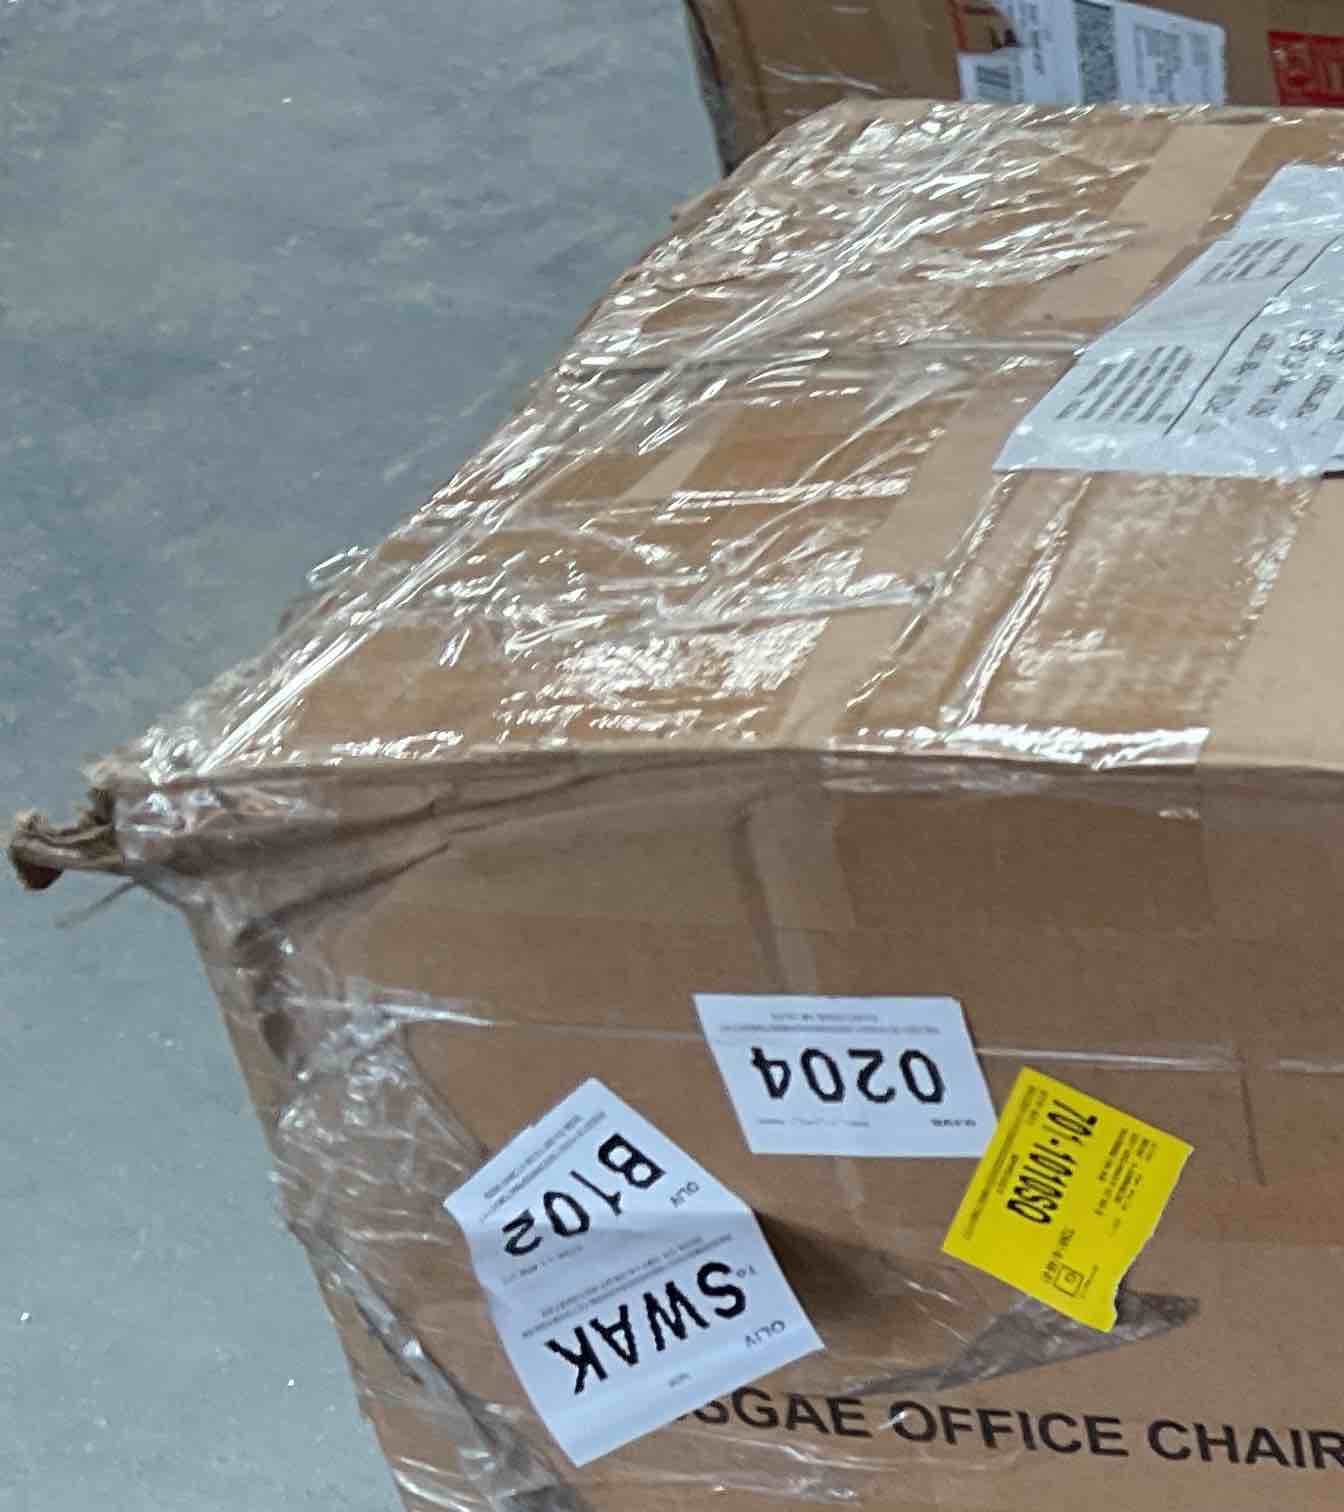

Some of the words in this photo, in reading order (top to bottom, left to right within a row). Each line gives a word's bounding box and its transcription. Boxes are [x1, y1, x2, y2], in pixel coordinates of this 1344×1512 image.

[751, 1045, 945, 1106] 0204
[502, 1133, 665, 1258] B102
[544, 1260, 749, 1396] SWAK
[888, 1400, 1129, 1456] OFFICE
